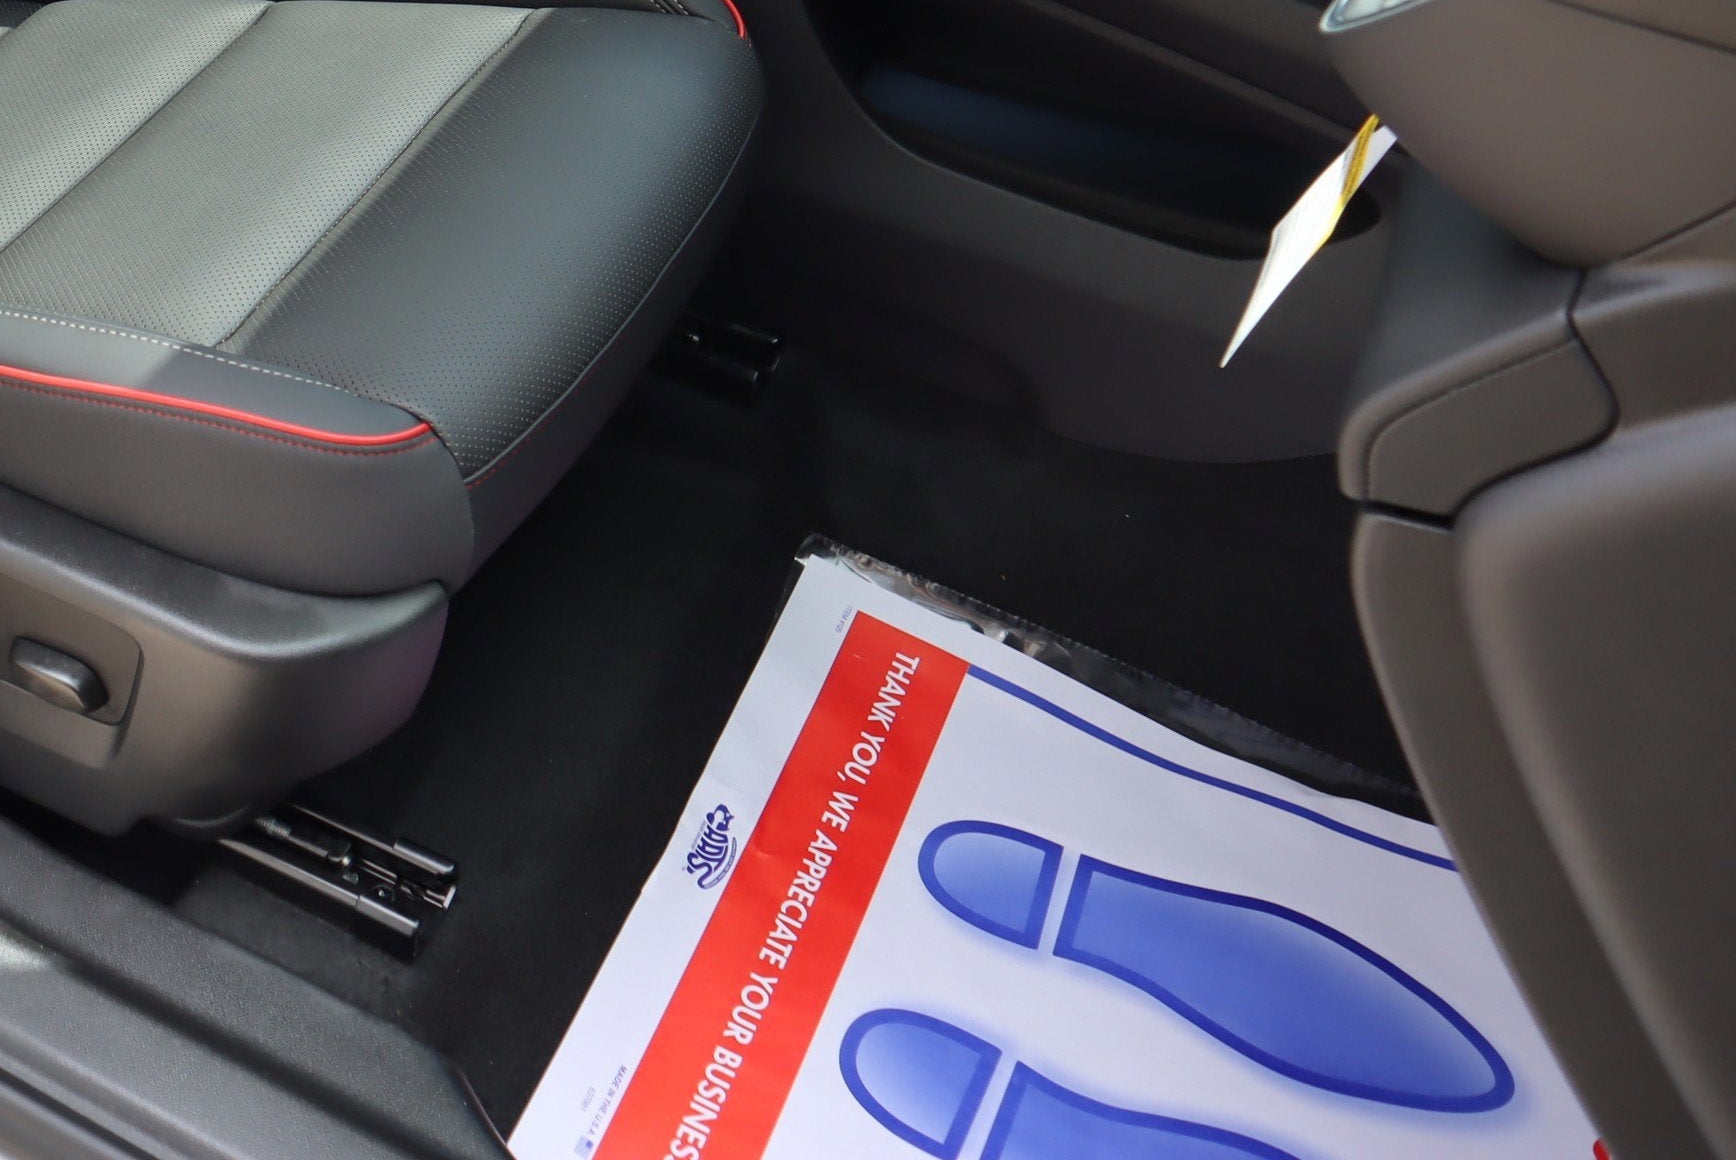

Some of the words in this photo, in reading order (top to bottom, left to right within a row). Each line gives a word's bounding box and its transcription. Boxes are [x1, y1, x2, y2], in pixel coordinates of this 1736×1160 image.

[867, 651, 920, 732] THANK
[837, 731, 886, 785] YOU,
[821, 791, 859, 833] WE
[759, 829, 838, 970] APPRECIATE
[722, 972, 779, 1045] YOUR
[607, 1087, 616, 1098] IN
[611, 1065, 628, 1090] MADE
[663, 1045, 743, 1160] BUSINES
[598, 1098, 612, 1115] THE
